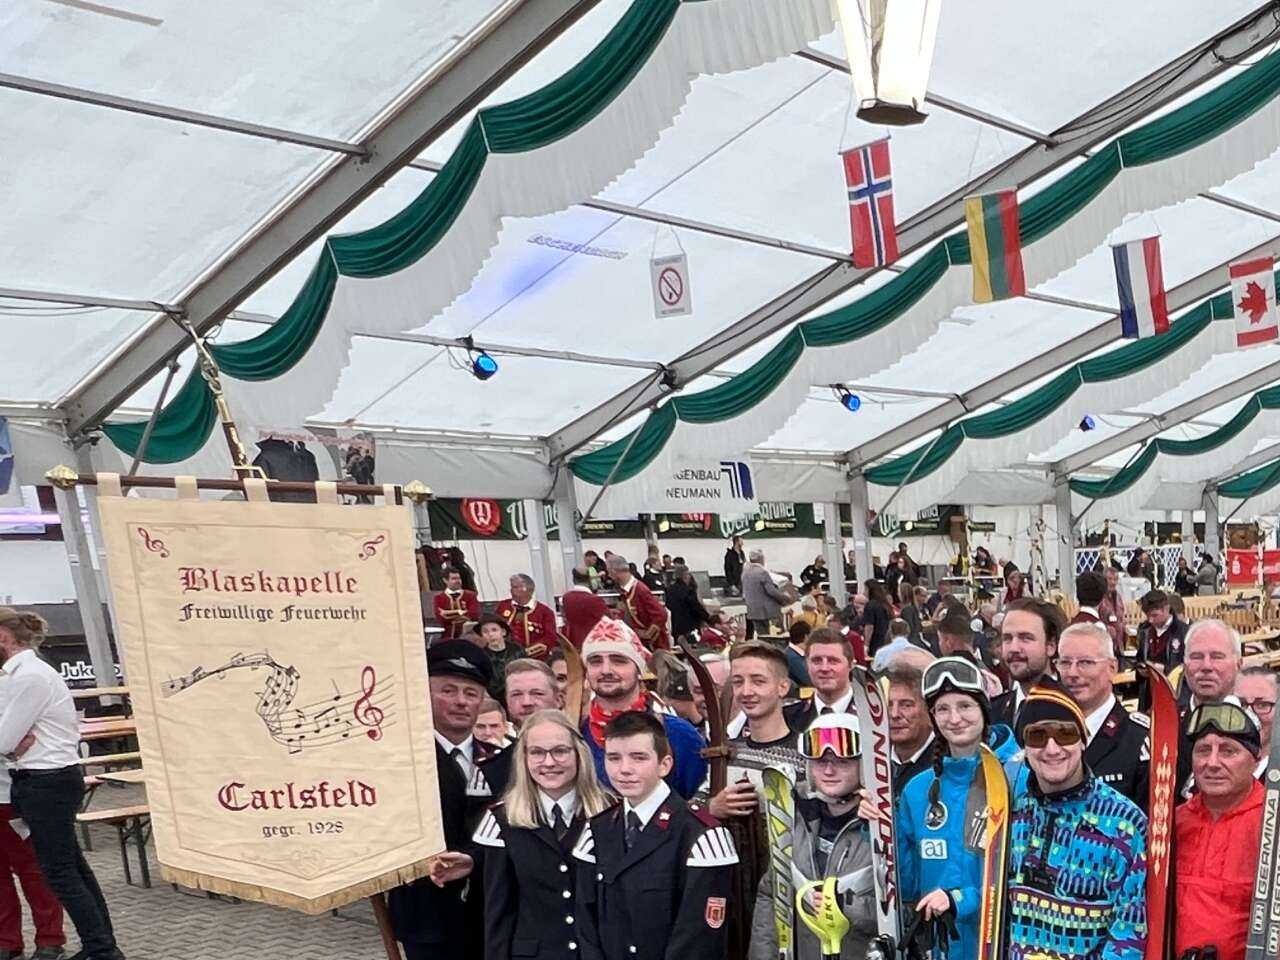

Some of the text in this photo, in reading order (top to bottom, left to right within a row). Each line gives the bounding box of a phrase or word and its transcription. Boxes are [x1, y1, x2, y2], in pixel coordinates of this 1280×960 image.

[666, 488, 721, 498] NEUMANN
[178, 567, 358, 597] Blaskapelle
[178, 603, 367, 623] Freiwillige Feuerwehr
[217, 779, 377, 812] Carlsfeld
[262, 820, 345, 838] gegr. 1928
[1258, 798, 1277, 894] GERMINA
